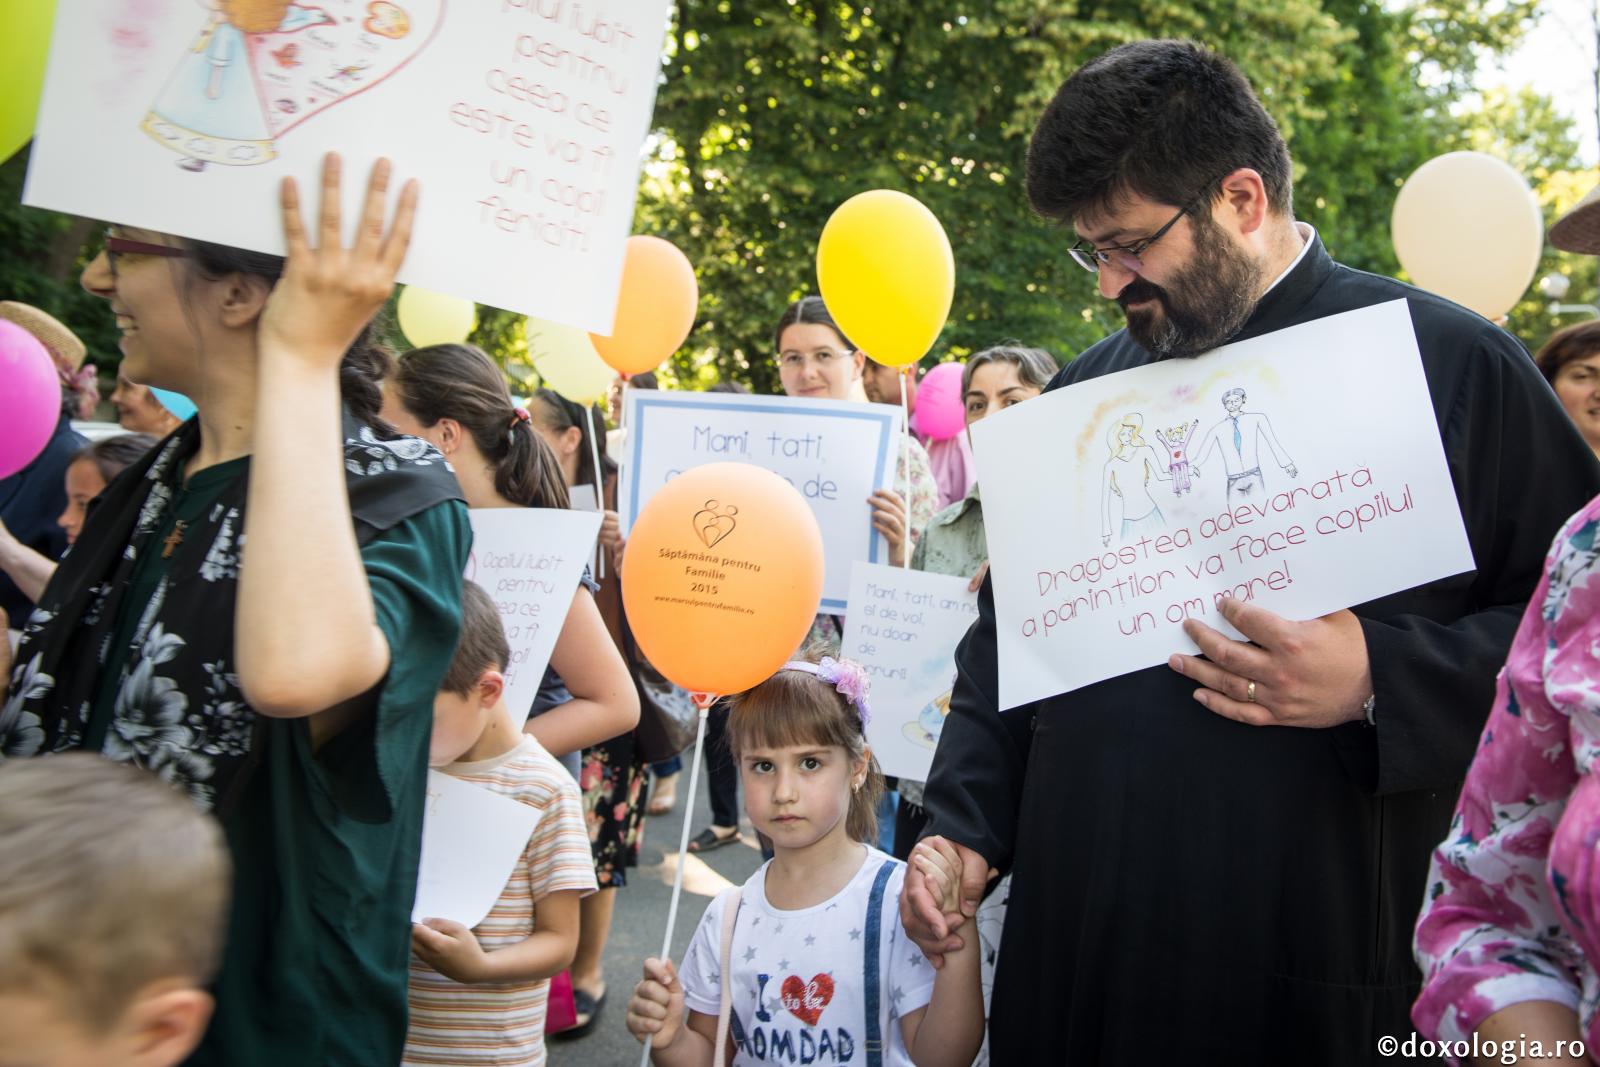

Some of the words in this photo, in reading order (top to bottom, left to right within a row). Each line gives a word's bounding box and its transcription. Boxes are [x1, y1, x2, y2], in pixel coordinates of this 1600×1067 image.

[512, 34, 629, 94] pentru
[486, 69, 568, 115] ceea
[574, 102, 610, 133] ce
[449, 102, 535, 148] este
[544, 133, 583, 163] va
[490, 160, 533, 192] un
[540, 178, 607, 217] copil
[803, 473, 838, 501] de
[684, 565, 726, 581] Familie
[721, 557, 761, 573] pentru
[1021, 617, 1037, 637] a
[1185, 553, 1225, 580] va
[1229, 525, 1307, 565] face
[1315, 483, 1414, 534] copilul
[1037, 527, 1193, 597] Dragostea
[495, 576, 556, 596] pentru
[690, 582, 719, 595] 2015
[1118, 611, 1156, 636] un
[1165, 597, 1206, 624] om
[1212, 559, 1293, 612] mare!
[860, 624, 880, 637] nu
[880, 606, 898, 622] de
[858, 642, 876, 657] de
[755, 973, 771, 1022] I
[785, 992, 800, 1010] to
